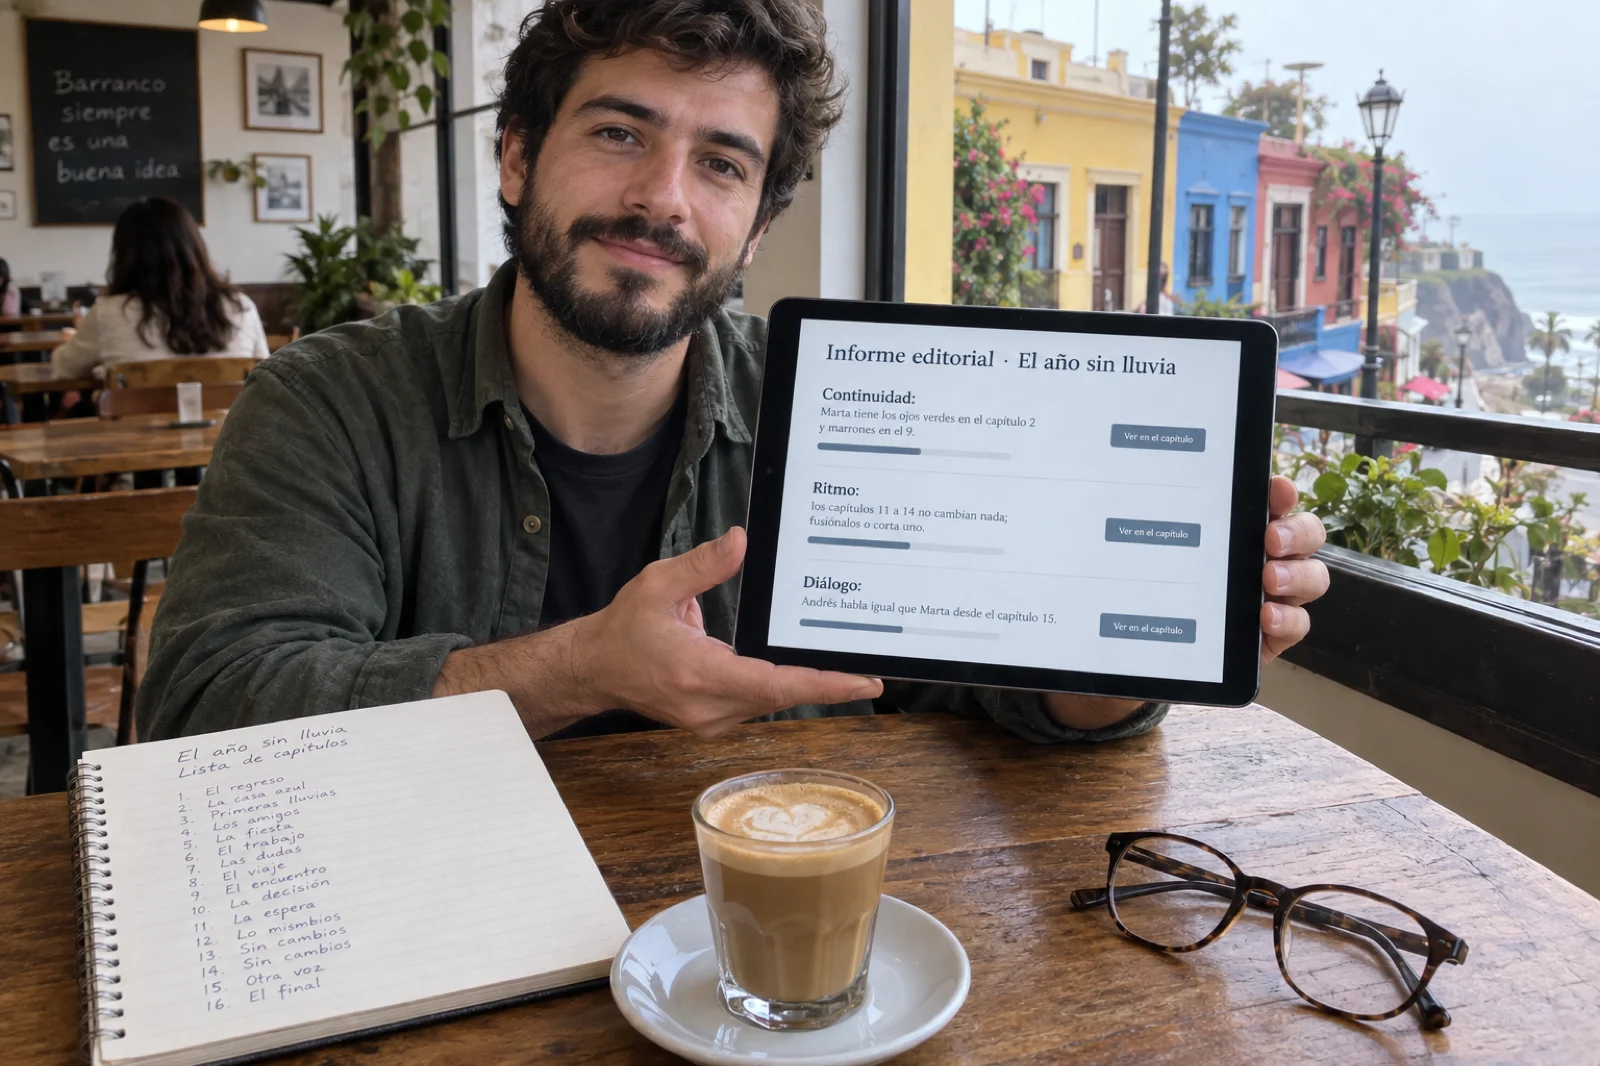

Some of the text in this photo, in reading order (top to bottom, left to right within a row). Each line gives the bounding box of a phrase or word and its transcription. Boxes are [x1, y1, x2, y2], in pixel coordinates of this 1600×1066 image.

[53, 70, 166, 94] Barranco
[61, 102, 152, 127] siempre
[48, 133, 128, 152] es una
[57, 158, 179, 184] buena idea
[826, 344, 905, 363] Informe
[912, 348, 994, 367] editorial
[1018, 352, 1037, 369] El
[1044, 353, 1080, 371] año
[1086, 355, 1115, 372] sin
[1122, 356, 1176, 375] lluvia
[823, 388, 916, 404] Continuidad:
[821, 407, 850, 418] Marta
[854, 409, 878, 419] tiene
[882, 410, 896, 420] los
[900, 413, 920, 423] ojos
[923, 412, 955, 423] verdes
[974, 415, 982, 424] el
[986, 416, 1026, 428] capítulo
[1029, 418, 1036, 427] 2
[819, 425, 825, 433] y
[828, 425, 876, 434] marrones
[894, 426, 902, 435] el
[906, 427, 915, 436] 9.
[1124, 432, 1137, 440] Ver
[1152, 434, 1158, 442] el
[1161, 435, 1193, 444] capítulo
[813, 482, 859, 496] Ritmo:
[810, 516, 860, 528] fusiónalos
[874, 521, 899, 530] corta
[811, 501, 825, 511] los
[828, 503, 874, 514] capítulos
[878, 506, 889, 514] 11
[903, 507, 915, 516] 14
[934, 509, 976, 520] cambian
[980, 512, 1008, 524] nada;
[1119, 527, 1132, 535] Ver
[1147, 528, 1154, 536] el
[1156, 530, 1188, 539] capítulo
[804, 576, 862, 594] Diálogo:
[802, 596, 1057, 624] Andrés habla igual que Marta desde el capítulo 15.
[1113, 623, 1127, 631] Ver
[1142, 624, 1149, 633] el
[1150, 626, 1183, 635] capítulo
[178, 726, 347, 762] El año sin lluvia
[179, 762, 230, 778] Lista
[243, 754, 264, 765] de
[179, 776, 284, 801] 1. El regreso
[234, 792, 266, 803] casa
[276, 782, 306, 794] azul
[180, 790, 336, 825] 3. Primeras lluvias
[213, 820, 238, 831] Los
[248, 809, 300, 825] amigos
[184, 824, 294, 850] 5. La fiesta
[185, 831, 304, 862] 6. El trabajo
[187, 846, 301, 875] 7. Las dudas
[189, 863, 287, 887] 8. El viaje
[191, 866, 326, 901] 9. El encuentro
[192, 879, 330, 915] 10. La decisión
[234, 914, 252, 924] La
[264, 902, 316, 920] espera
[196, 937, 218, 946] 12.
[237, 929, 256, 940] Lo
[200, 926, 346, 961] 13. Sin cambios
[202, 940, 351, 977] 14. Sin cambios
[205, 965, 323, 994] 15. Otra voz
[207, 977, 320, 1011] 16. El final
